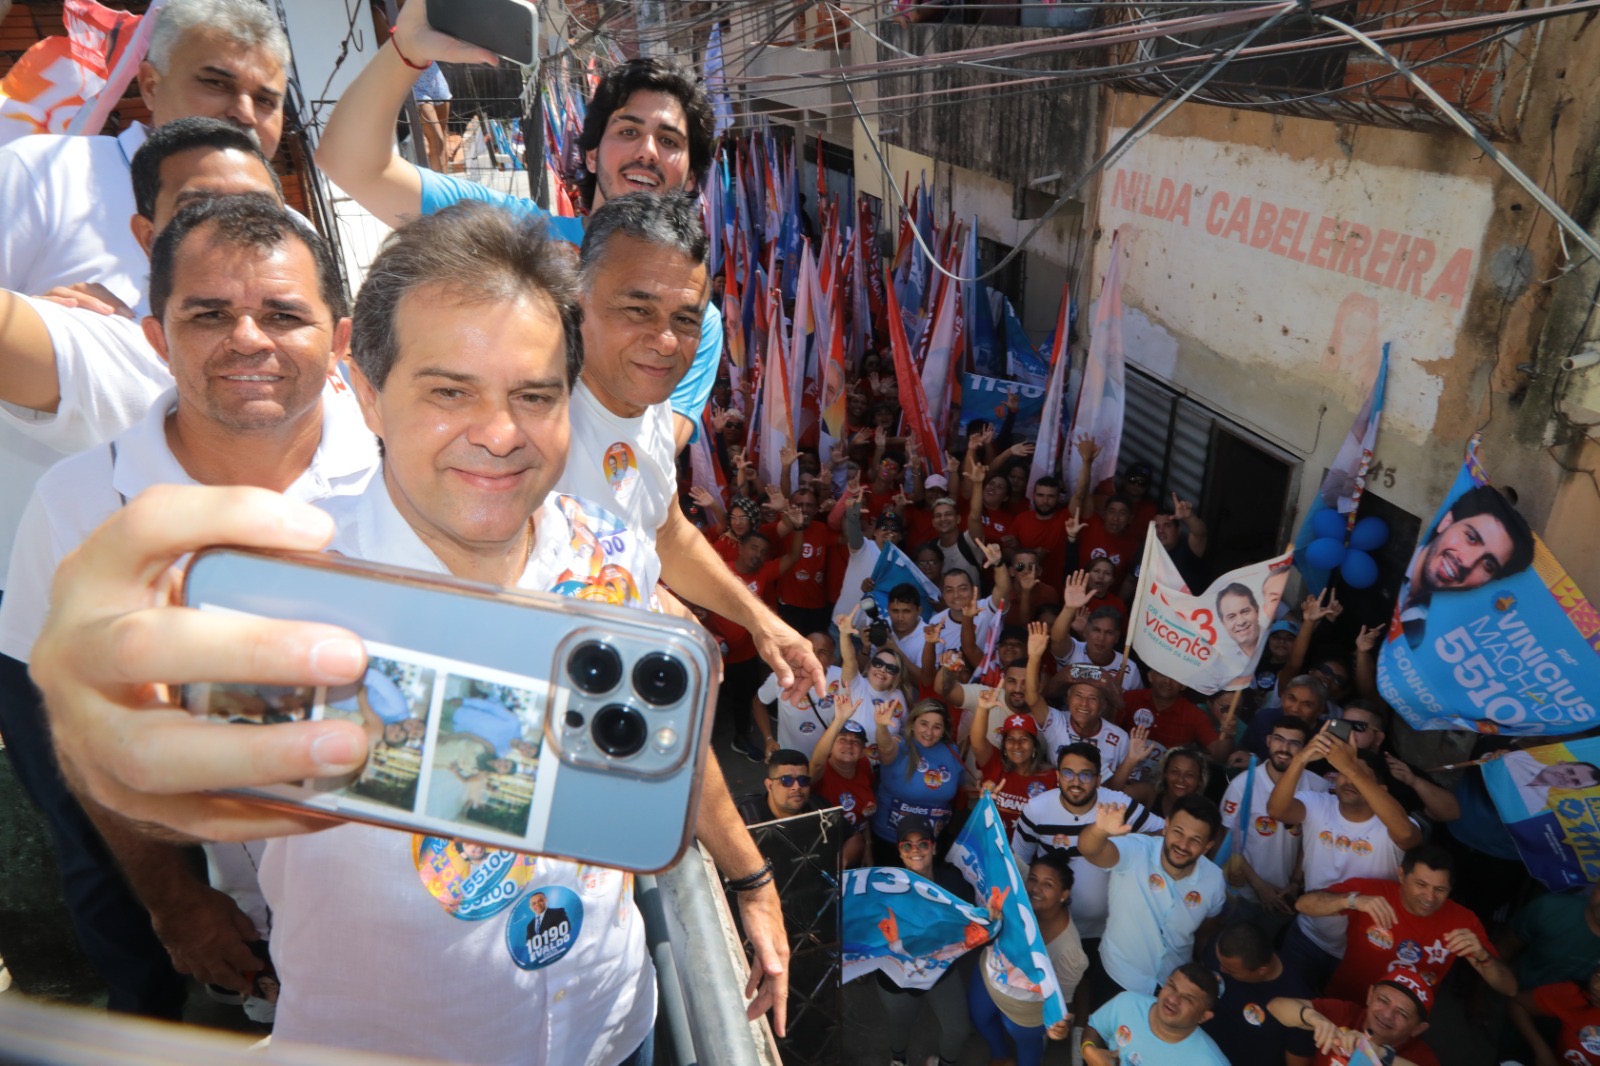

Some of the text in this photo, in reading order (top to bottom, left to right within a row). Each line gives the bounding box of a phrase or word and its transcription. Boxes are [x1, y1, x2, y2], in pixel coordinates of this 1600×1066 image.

[1111, 168, 1474, 310] NILDA CABELEIREIRA
[1394, 645, 1444, 714] SONHOS
[1496, 609, 1596, 722] VINICIUS
[900, 803, 929, 816] Eudes
[1224, 800, 1238, 814] 13
[526, 921, 570, 955] 10190
[530, 934, 571, 963] EVALDO
[1393, 974, 1421, 990] PT
